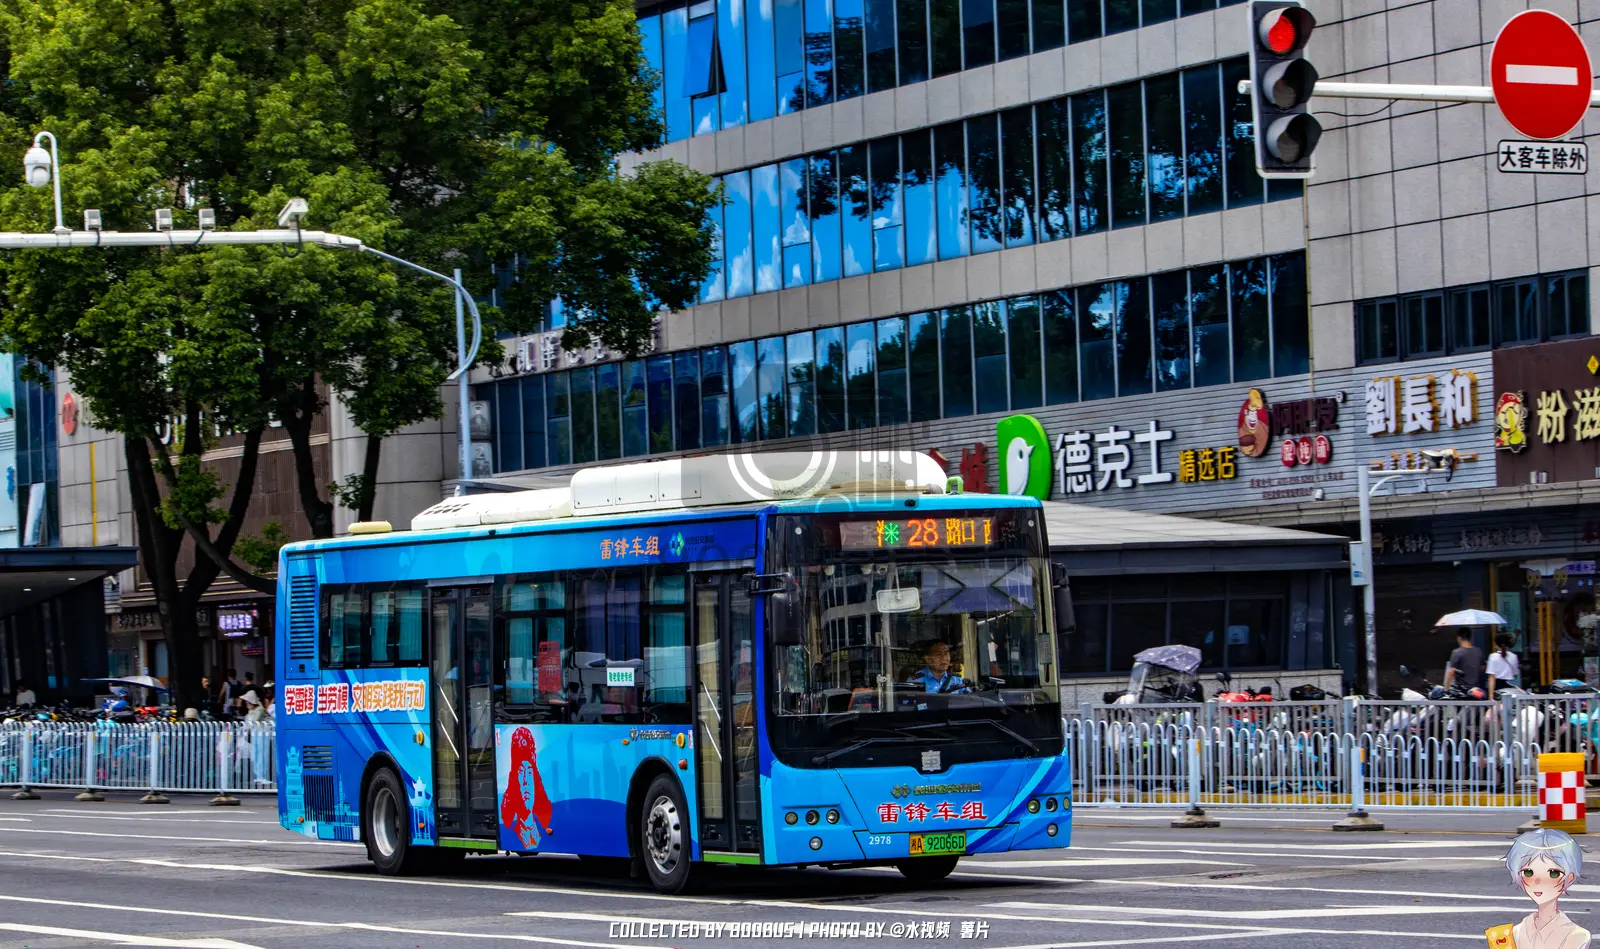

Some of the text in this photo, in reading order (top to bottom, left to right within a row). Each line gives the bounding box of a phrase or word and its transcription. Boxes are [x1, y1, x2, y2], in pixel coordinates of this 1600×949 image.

[1500, 145, 1585, 170] 大客车除外
[1366, 369, 1476, 435] 劉長和
[1055, 421, 1173, 494] 德克士
[1179, 446, 1235, 483] 精选店
[907, 518, 939, 547] 28
[600, 536, 660, 560] 雷锋车组
[285, 681, 425, 713] 学雷锋 当劳模 文明实践我行动
[877, 801, 988, 823] 雷锋车组
[868, 836, 892, 845] 2978
